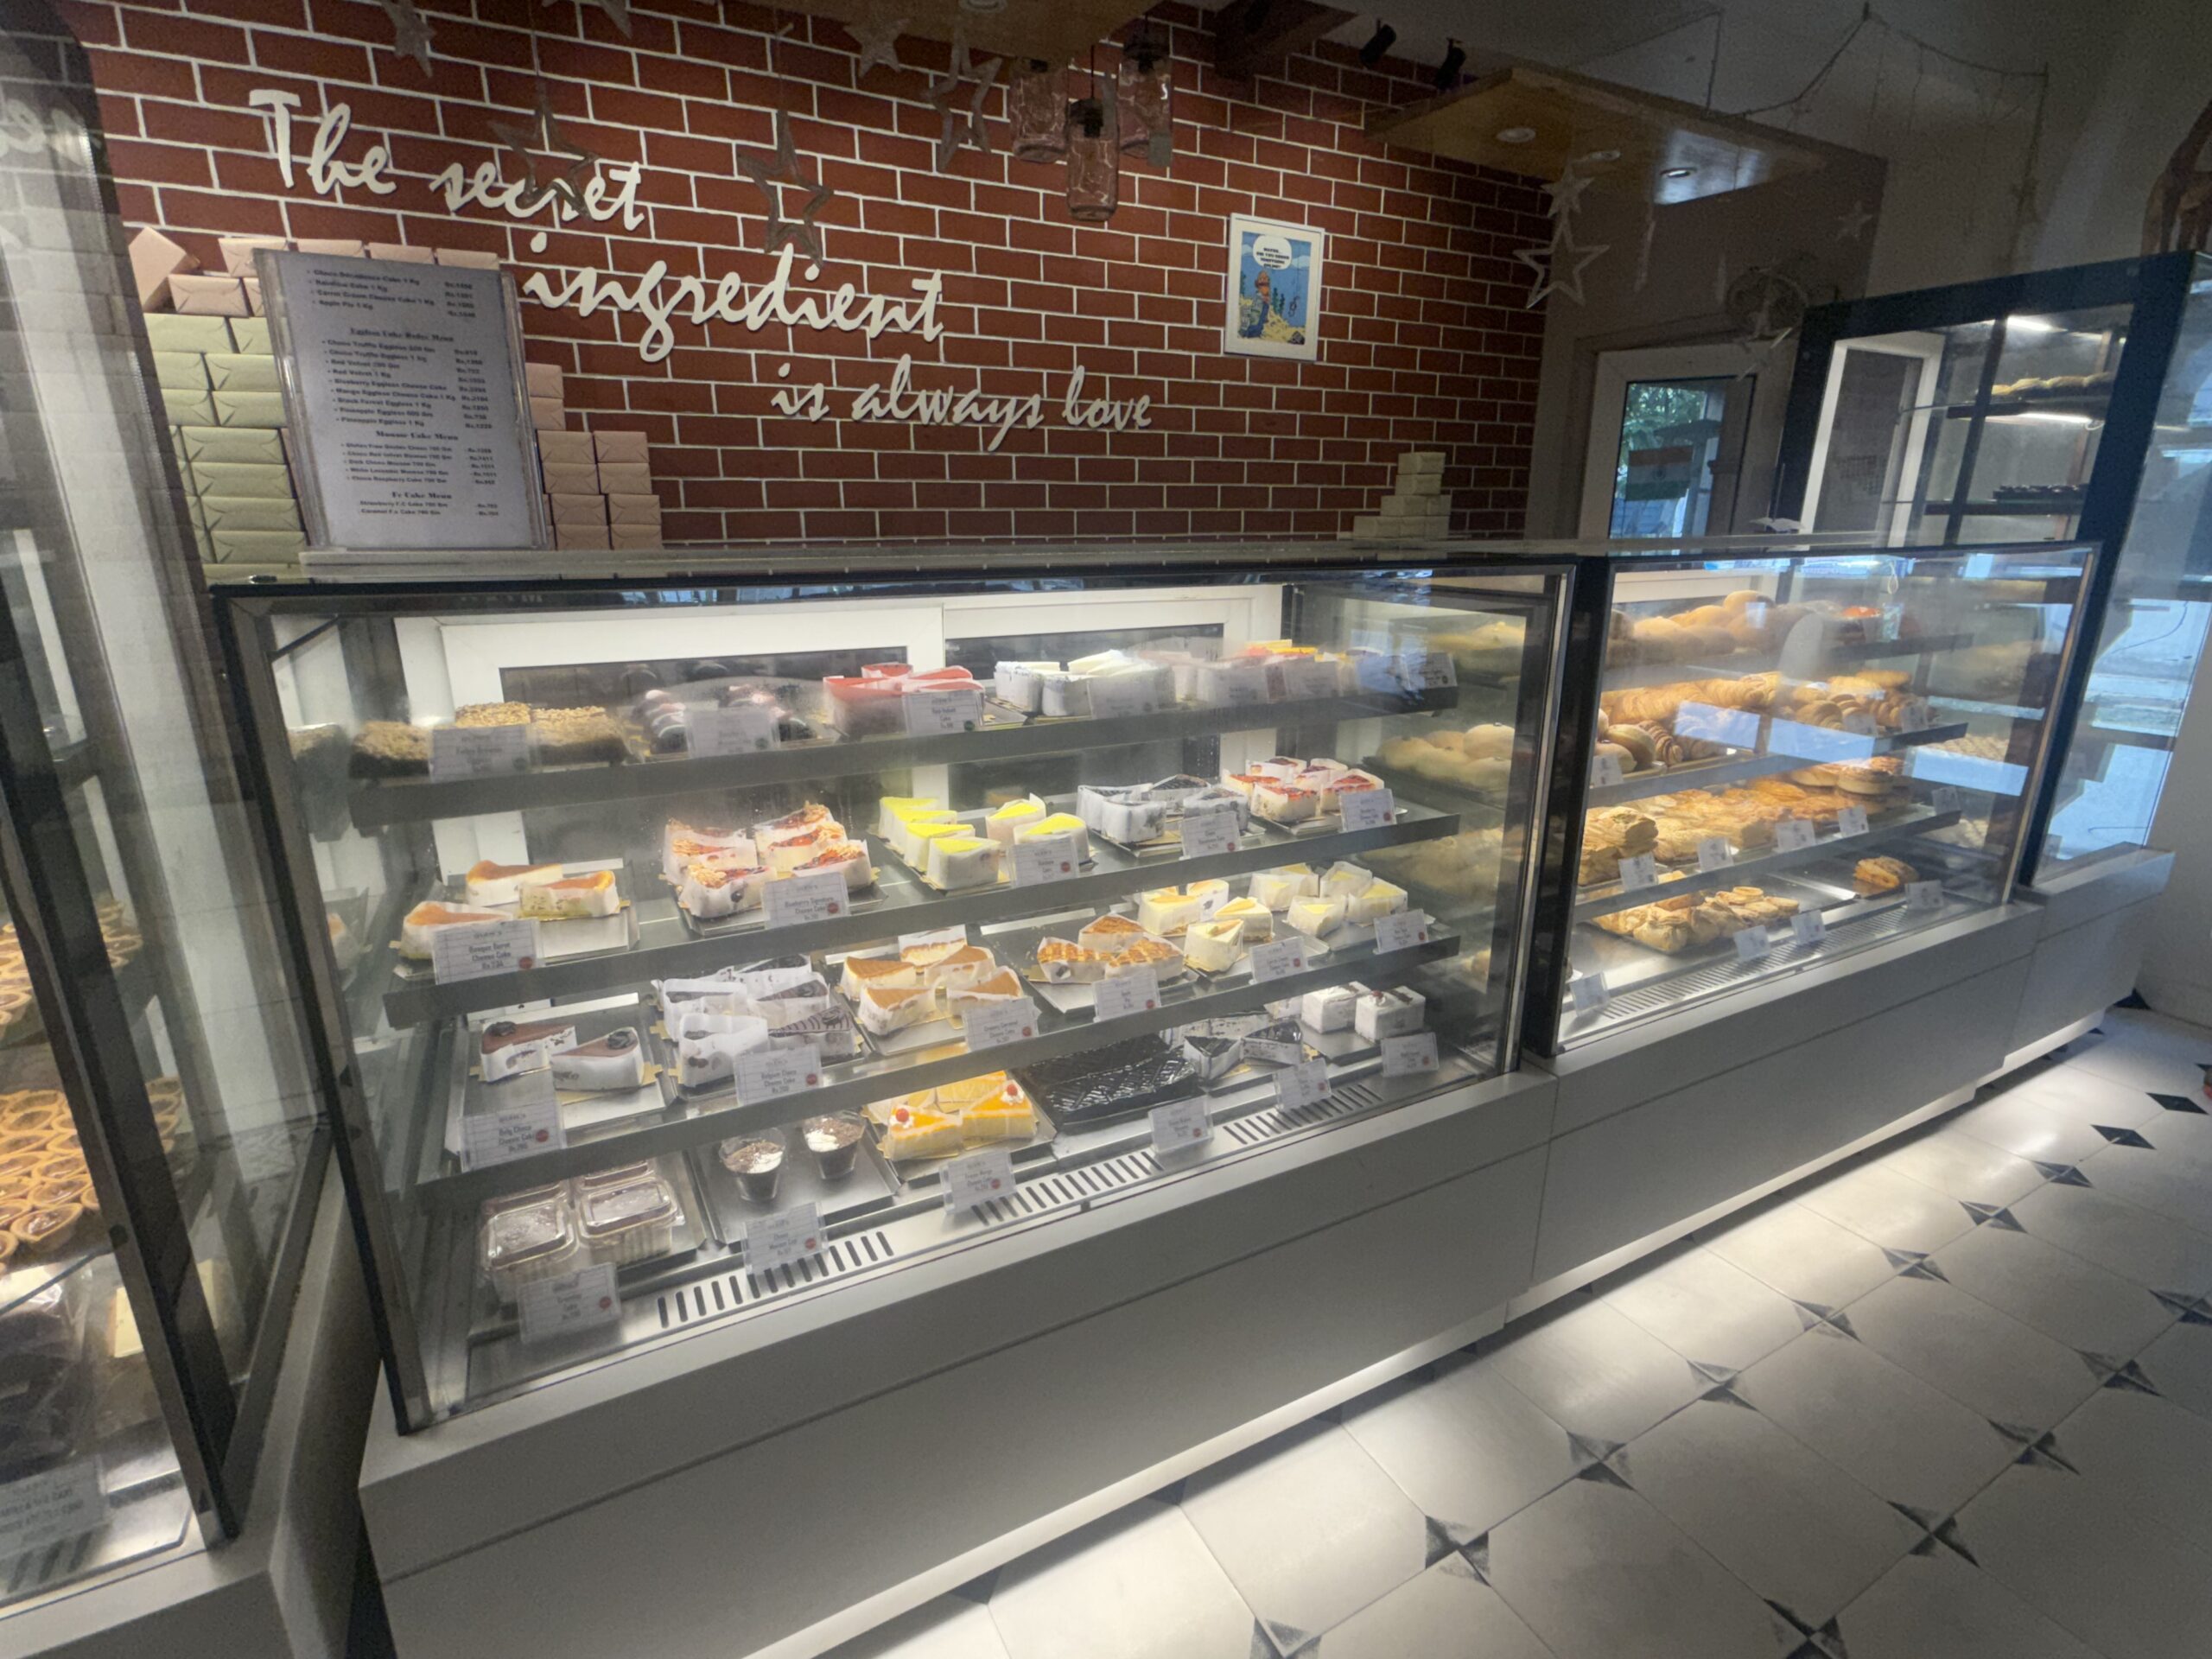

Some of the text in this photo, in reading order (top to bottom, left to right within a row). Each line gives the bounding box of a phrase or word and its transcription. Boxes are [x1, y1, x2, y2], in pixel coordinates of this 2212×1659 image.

[248, 89, 645, 231] The secret
[524, 231, 944, 361] ingredient
[771, 354, 1154, 450] is always love
